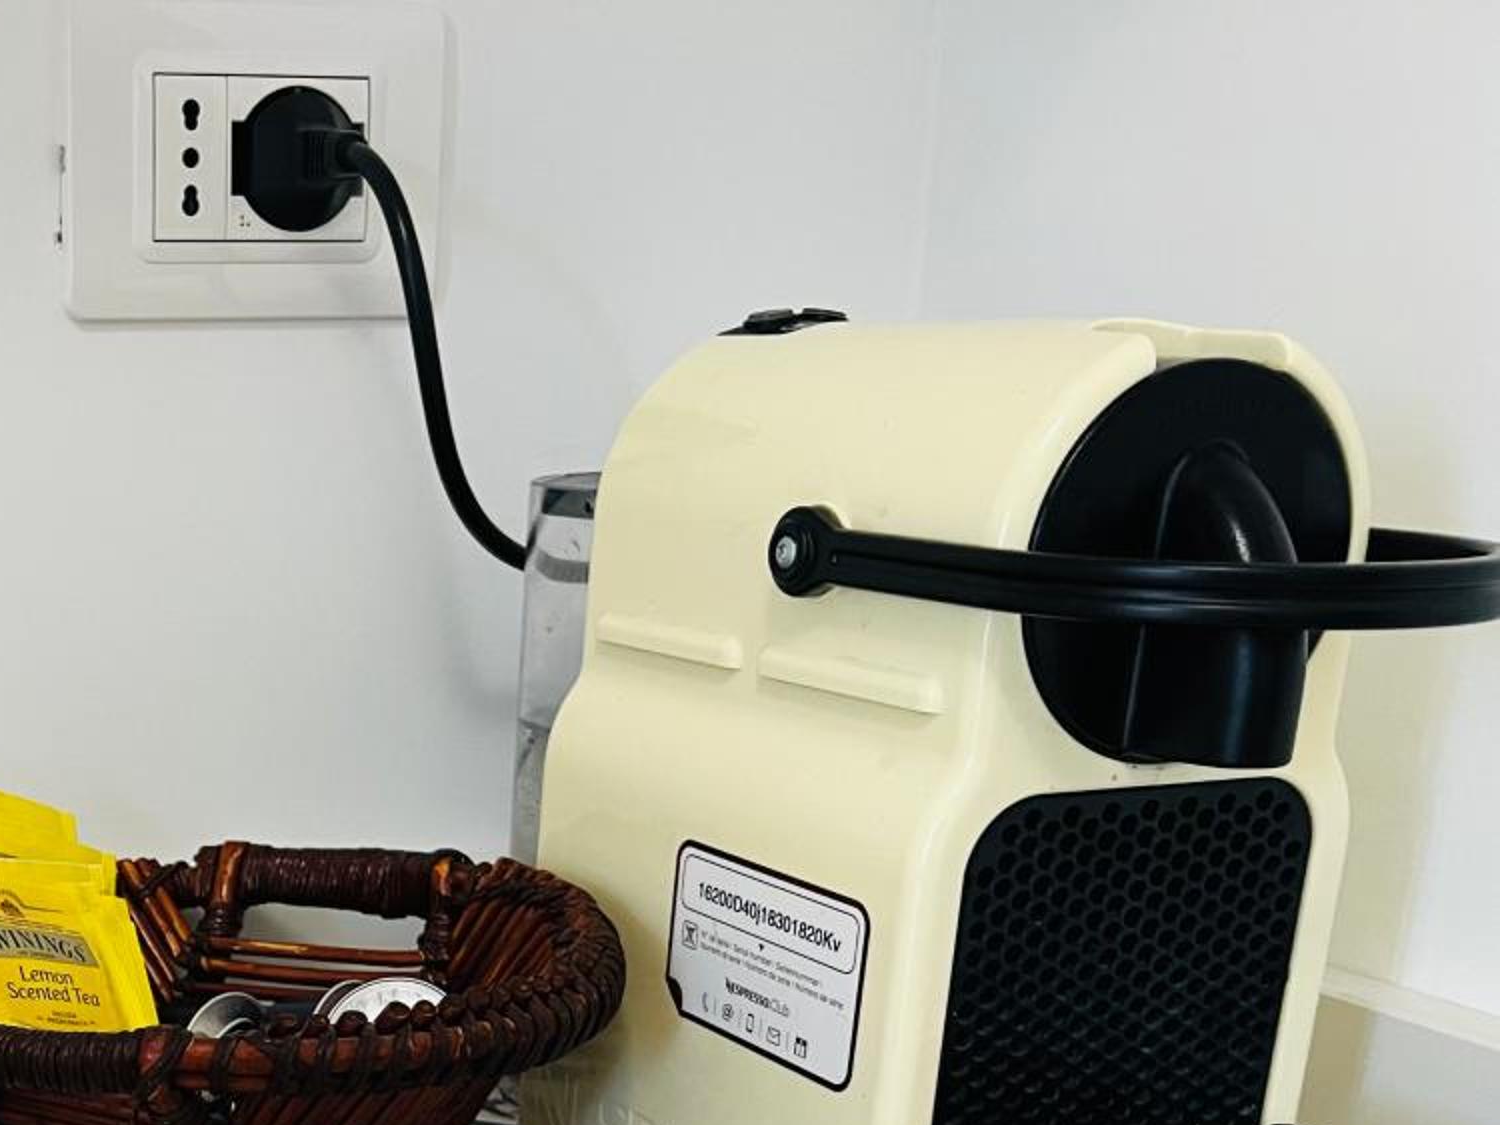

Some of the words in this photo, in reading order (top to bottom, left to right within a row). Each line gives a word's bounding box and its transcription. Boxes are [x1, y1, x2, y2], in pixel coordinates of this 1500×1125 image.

[19, 965, 74, 987] Lemon
[6, 981, 71, 1002] Scented
[72, 987, 100, 1007] Tea
